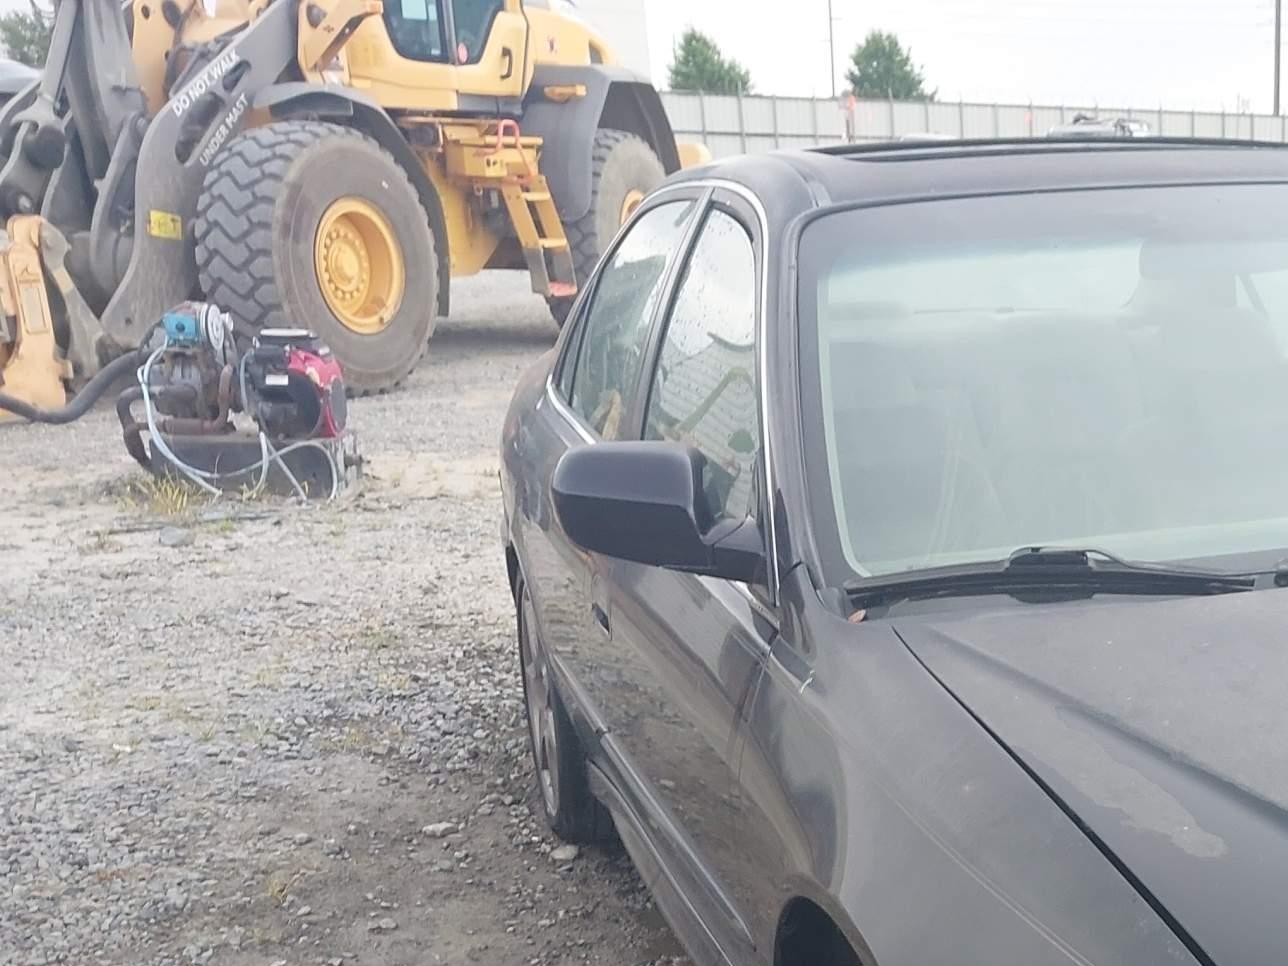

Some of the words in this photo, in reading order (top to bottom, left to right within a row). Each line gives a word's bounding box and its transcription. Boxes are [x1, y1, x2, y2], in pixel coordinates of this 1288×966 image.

[172, 94, 190, 118] DO
[189, 72, 211, 103] NOT
[209, 48, 240, 80] WALK
[199, 124, 230, 167] UNDER
[225, 92, 249, 129] MAST
